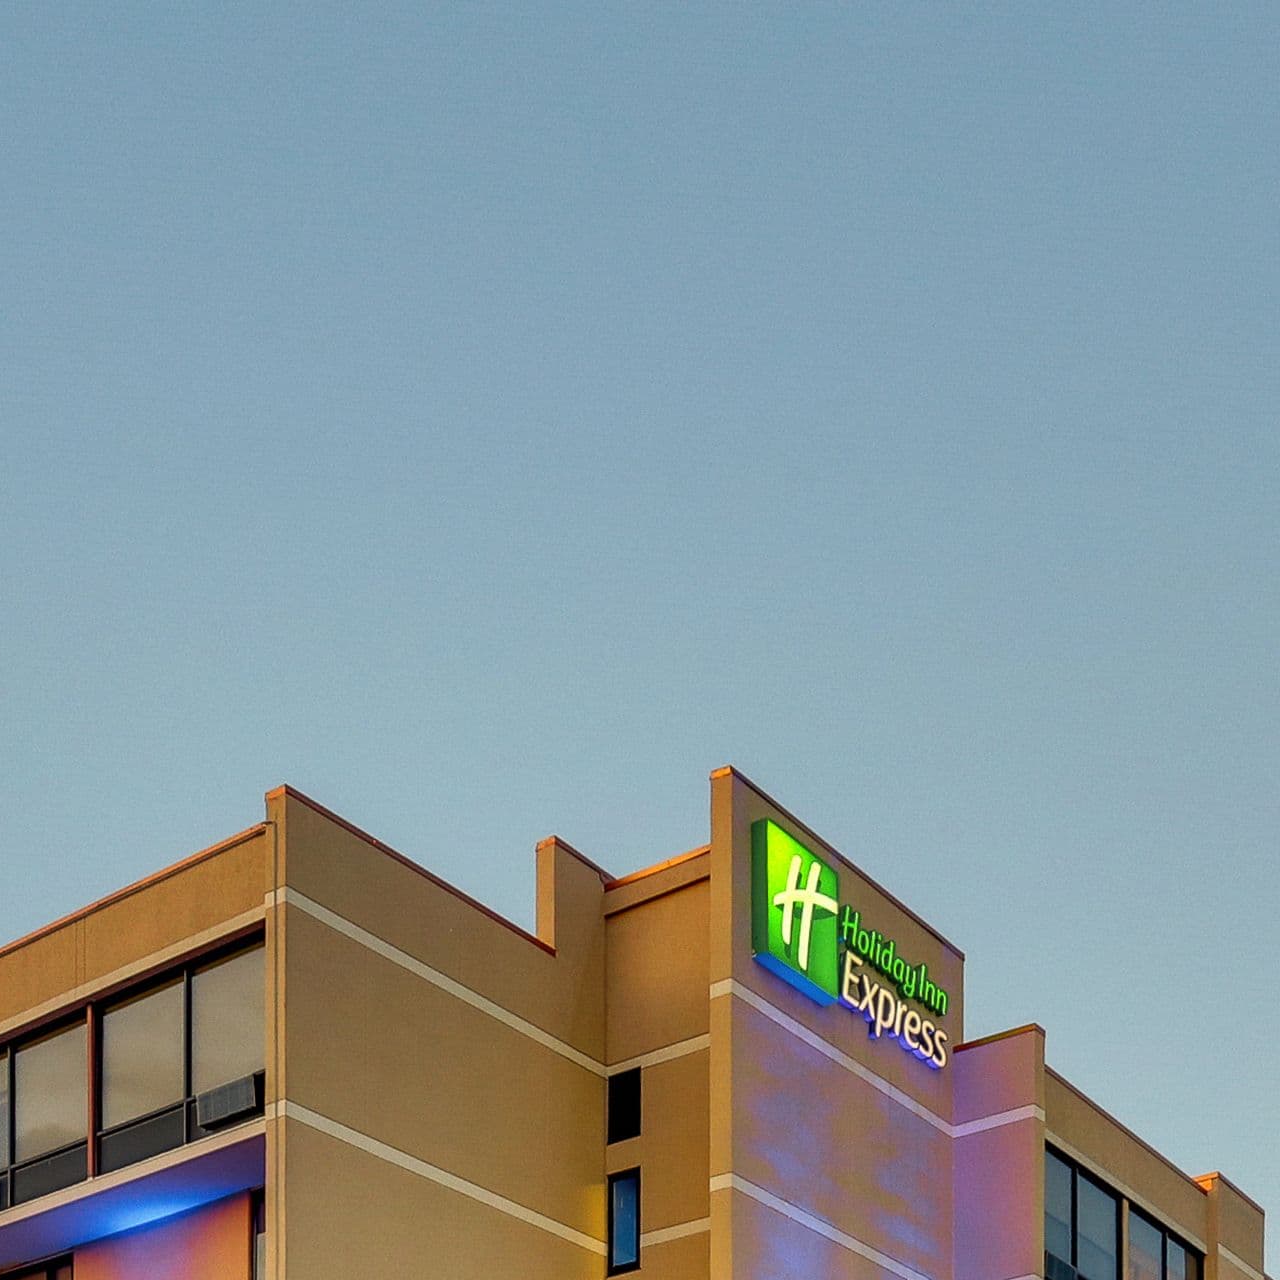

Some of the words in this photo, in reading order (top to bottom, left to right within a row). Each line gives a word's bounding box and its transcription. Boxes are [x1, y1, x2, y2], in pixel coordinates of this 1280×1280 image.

[773, 854, 839, 971] H
[841, 905, 917, 998] Holiday
[920, 964, 949, 1016] Inn
[841, 950, 949, 1069] Express
